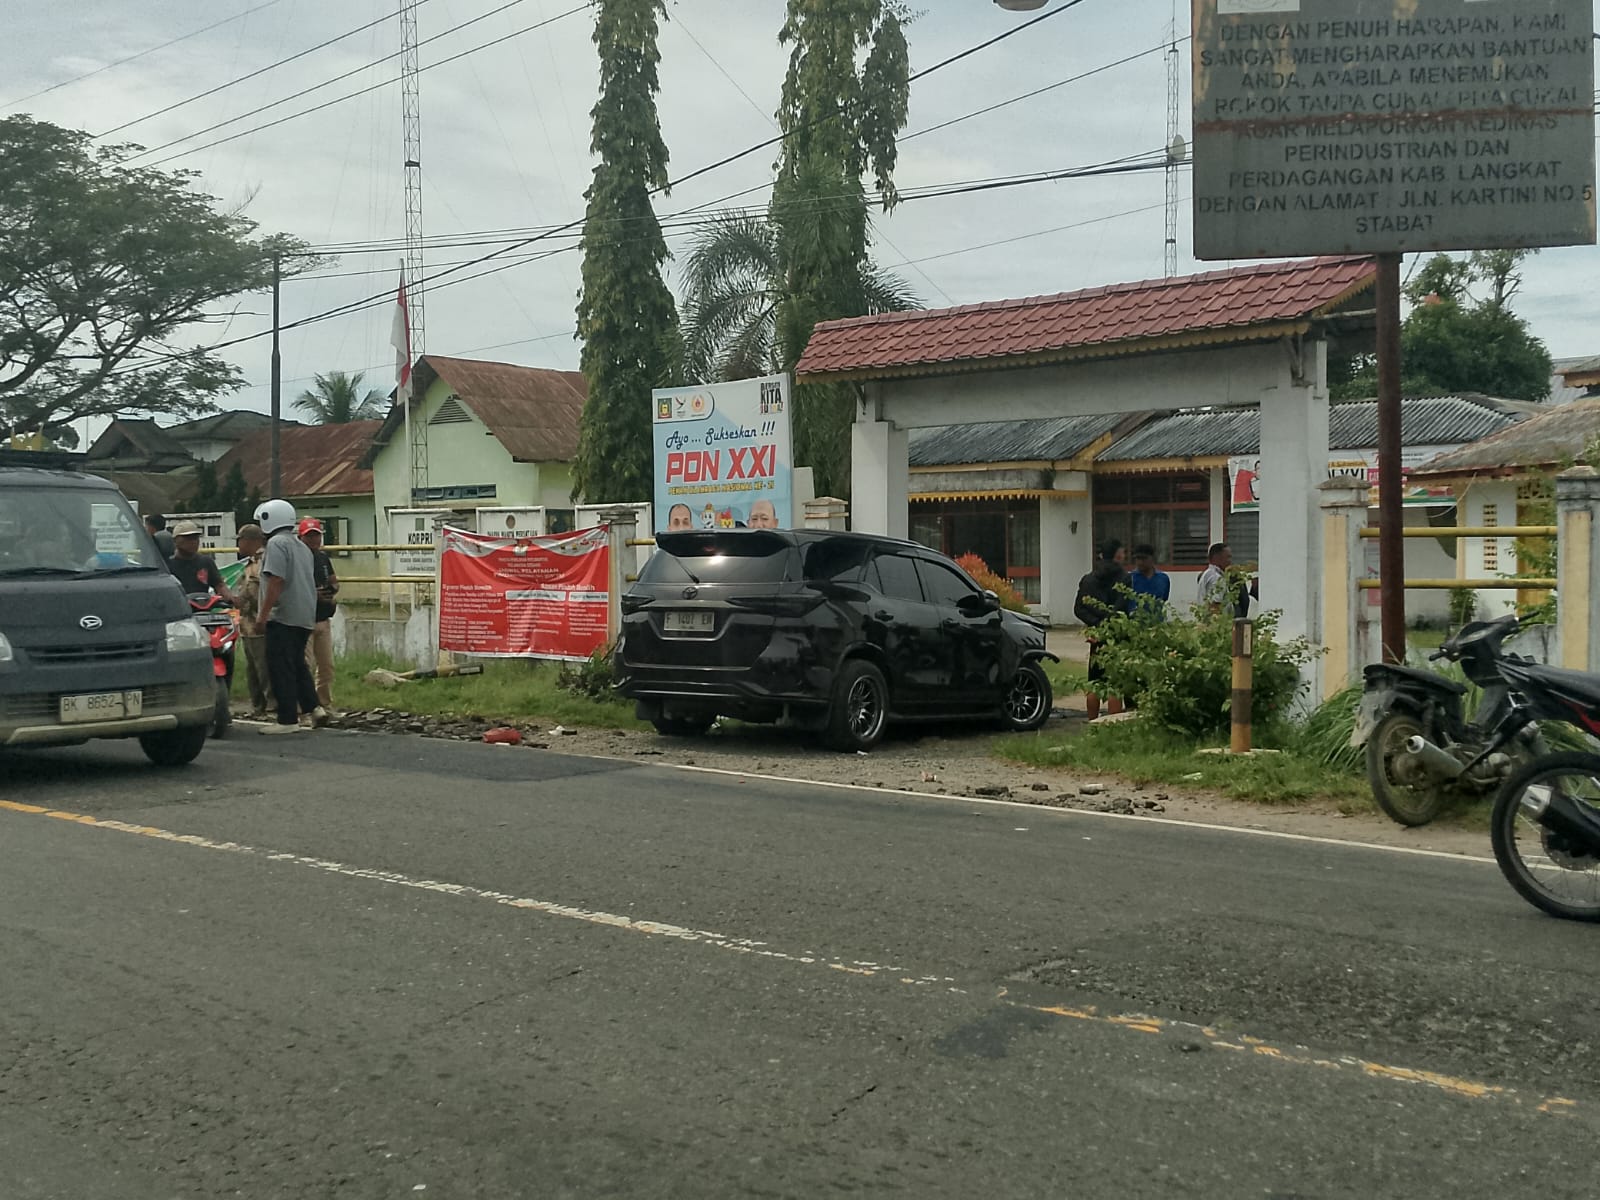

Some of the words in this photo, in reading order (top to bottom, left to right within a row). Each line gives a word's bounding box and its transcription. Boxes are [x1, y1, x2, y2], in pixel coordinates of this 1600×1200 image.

[1221, 22, 1309, 41] DENGAN
[1317, 20, 1389, 39] PENUH
[1513, 12, 1567, 31] KAMI
[1200, 47, 1284, 67] SANGAT
[1293, 42, 1475, 65] MENGHARAPKAN
[1483, 37, 1587, 58] BANTUAN
[1312, 68, 1401, 88] APABILA
[1409, 63, 1549, 85] MENEMUKAN
[1285, 141, 1457, 162] PERINDUSTRIAN
[1465, 139, 1509, 157] DAN
[1229, 168, 1394, 189] PERDAGANGAN
[1458, 161, 1562, 181] LANGKAT
[1200, 194, 1286, 213] DENGAN
[1294, 192, 1379, 211] ALAMAT
[1450, 186, 1537, 206] KARTINI
[1581, 184, 1593, 201] 5
[1356, 214, 1433, 233] STABAT
[666, 430, 688, 450] Ayo
[705, 425, 757, 446] Sukseskan
[666, 449, 720, 483] PON
[726, 444, 776, 479] XXI
[408, 533, 433, 545] KORPRI
[63, 698, 78, 711] BK
[87, 694, 115, 709] 8652
